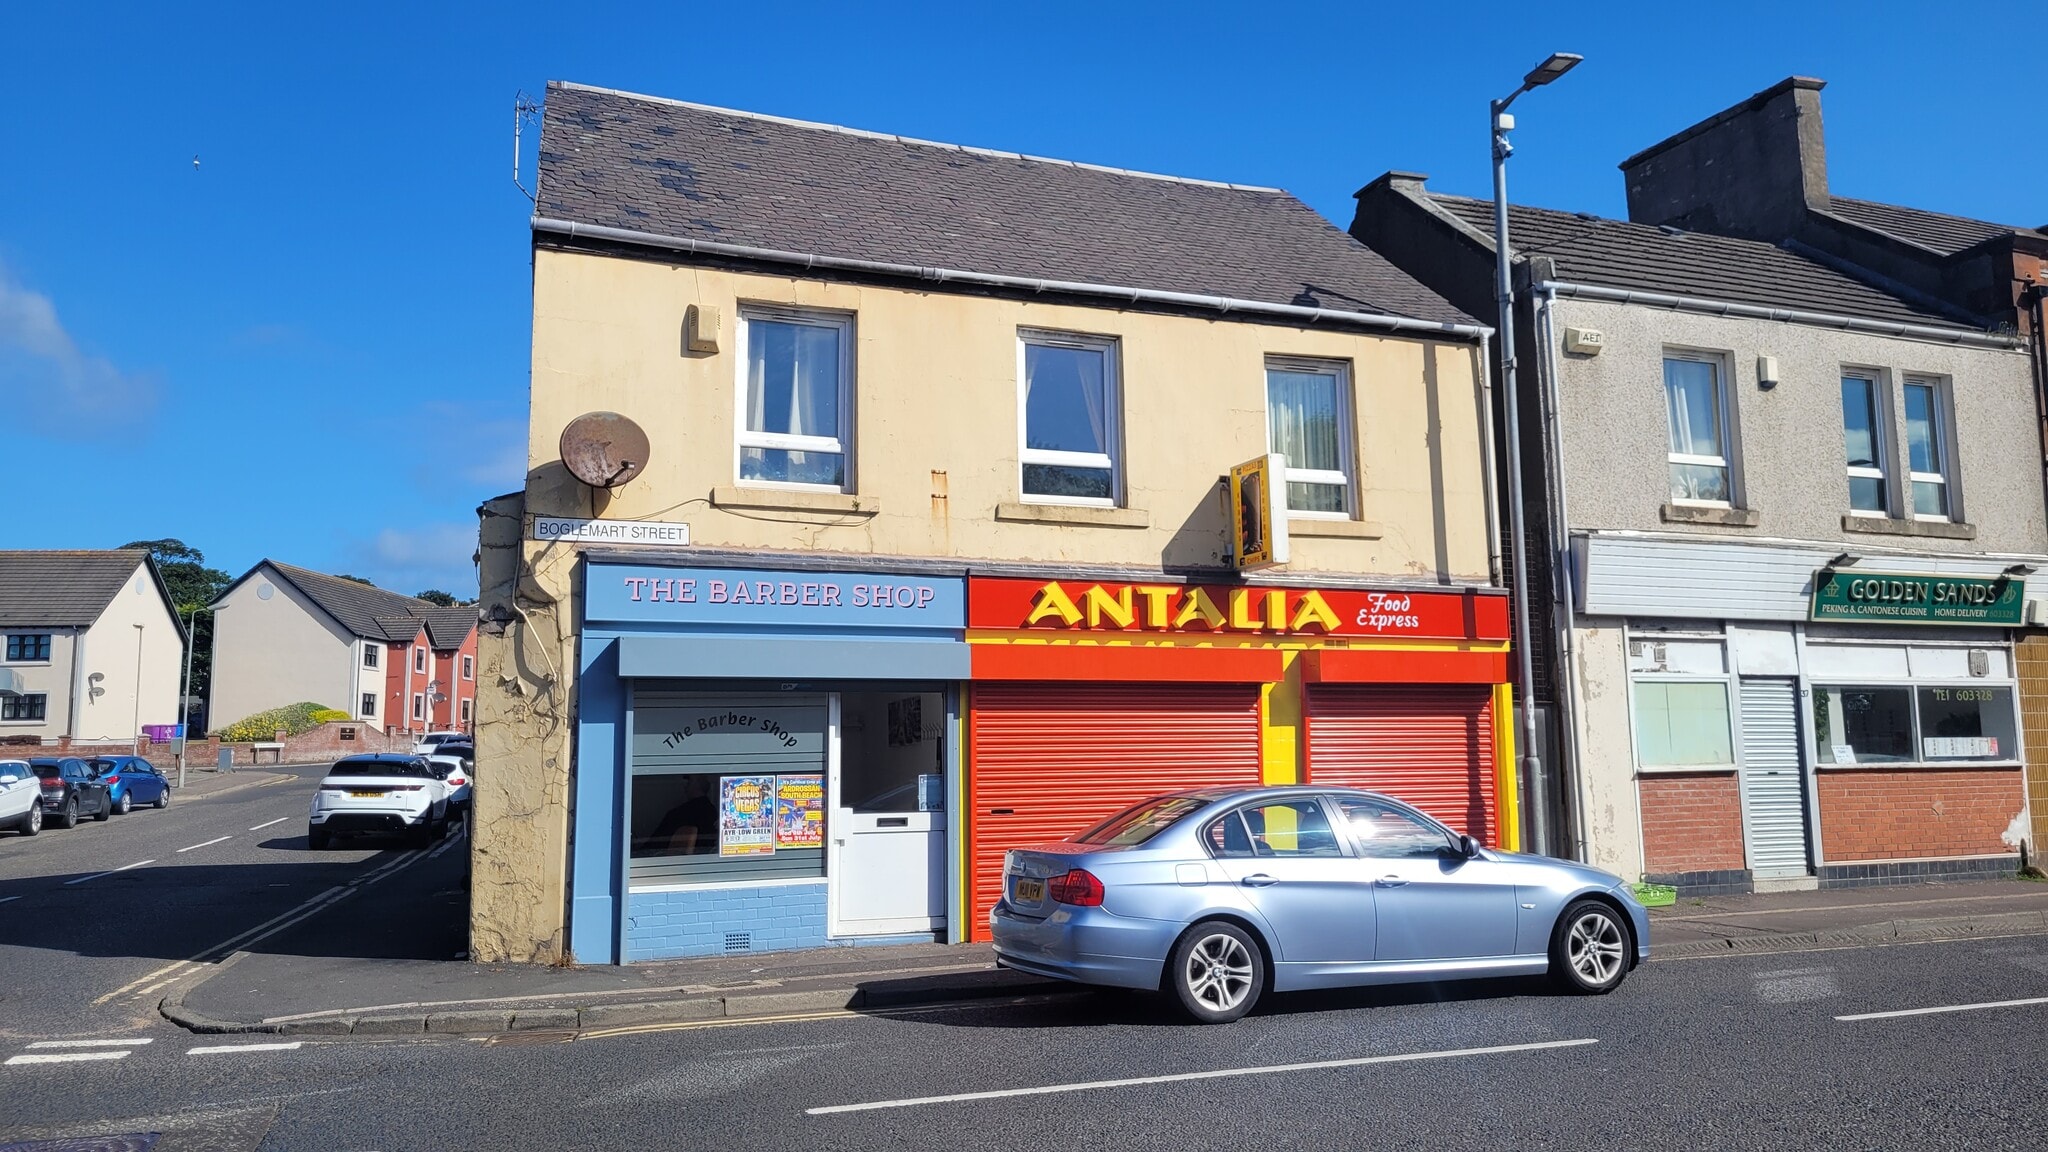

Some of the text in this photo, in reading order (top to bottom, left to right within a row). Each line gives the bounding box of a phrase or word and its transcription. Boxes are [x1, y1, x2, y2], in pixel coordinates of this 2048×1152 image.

[539, 522, 684, 540] BOGLEMART STREET
[1246, 556, 1261, 565] CHIPS
[624, 577, 935, 608] THE BARBER SHOP
[1850, 579, 1997, 604] GOLDEN SANDS
[1026, 580, 1342, 633] ANTALIA
[1367, 593, 1411, 614] Food
[1822, 604, 1849, 614] PEKING
[1849, 605, 1856, 614] &
[1857, 605, 1900, 616] CANTONESE
[1900, 607, 1928, 616] CUISINE
[1934, 608, 1956, 617] HOME
[1957, 609, 1988, 618] DELIVERY
[1356, 608, 1419, 632] Express
[1956, 689, 1993, 701] 603328
[662, 711, 798, 749] The Barber Shop
[735, 785, 760, 798] CIRCUS
[782, 784, 821, 792] ARDROSSAN
[735, 799, 760, 812] VEGAS
